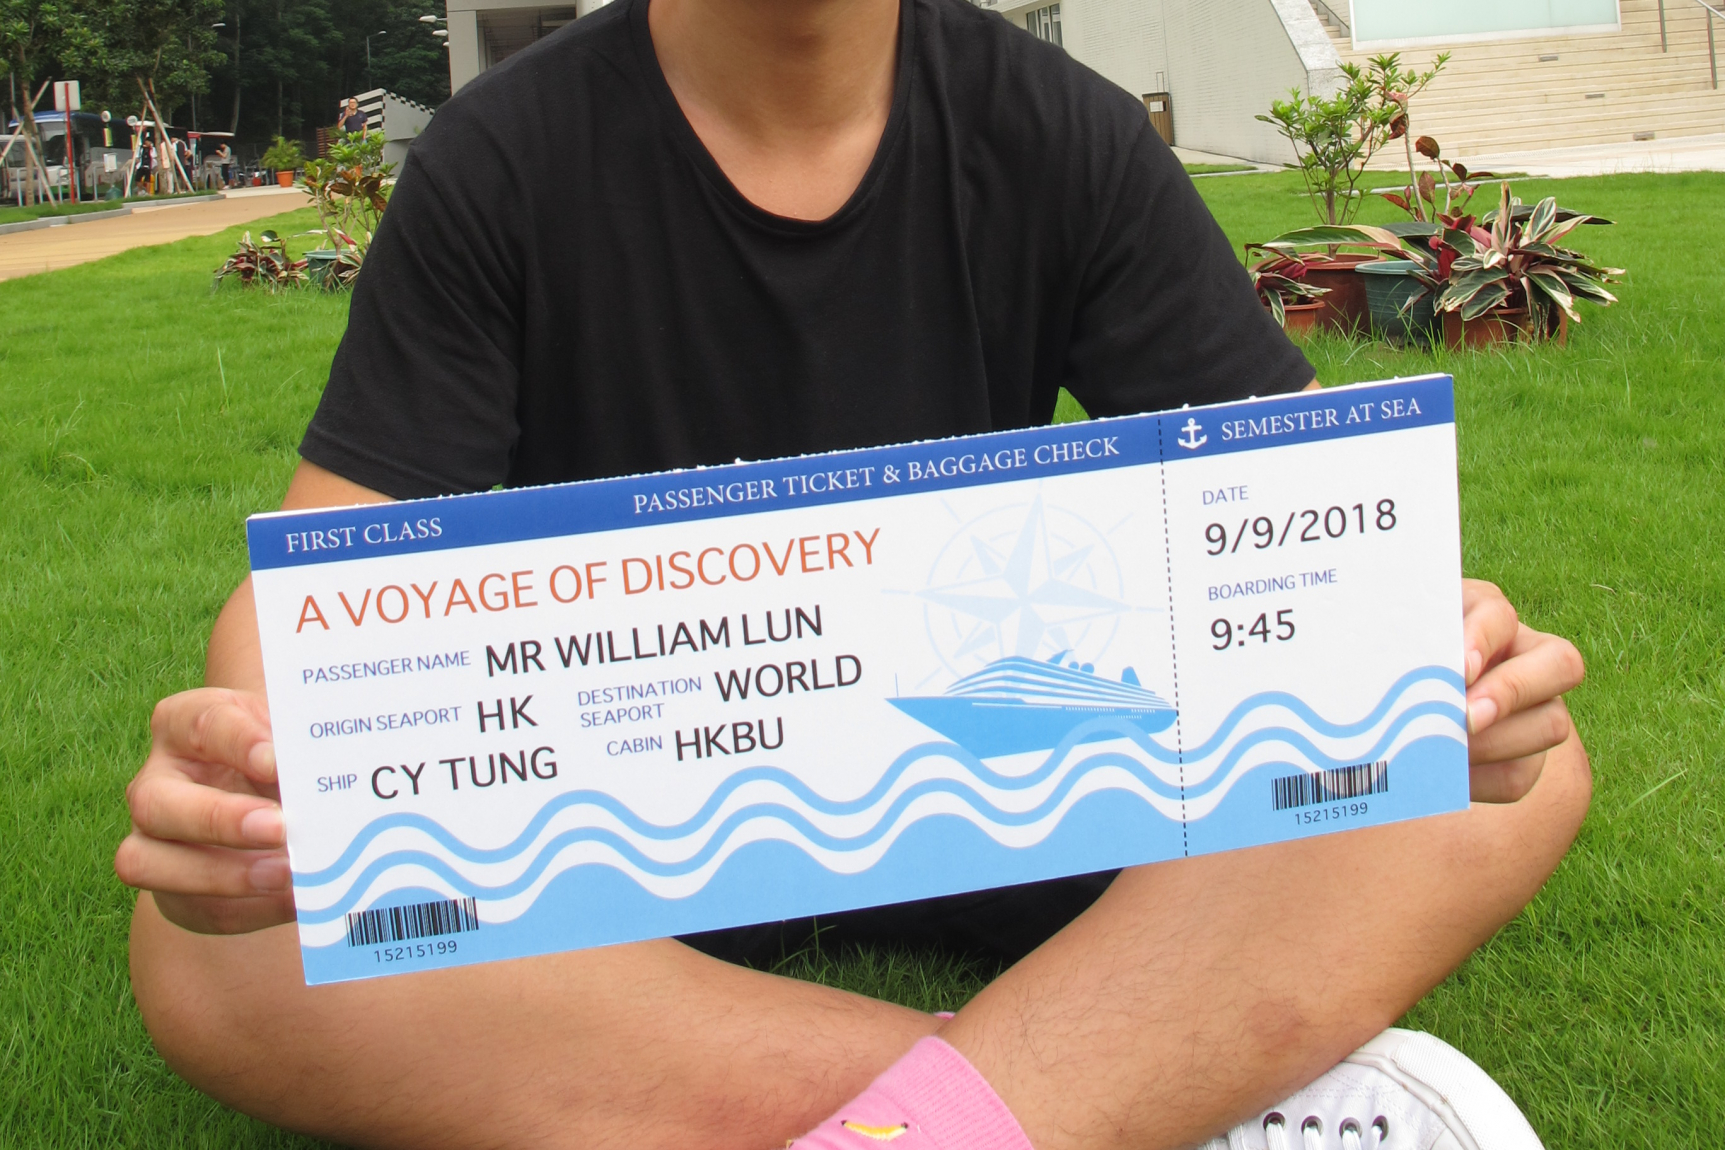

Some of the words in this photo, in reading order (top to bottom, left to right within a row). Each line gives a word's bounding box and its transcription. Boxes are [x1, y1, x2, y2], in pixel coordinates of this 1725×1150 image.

[1221, 410, 1340, 441] SEMESTER
[1345, 403, 1375, 426] AT
[1381, 397, 1422, 419] SEA
[634, 480, 777, 514] PASSENGER
[783, 466, 875, 496] TICKET
[882, 464, 901, 483] &
[907, 448, 1028, 481] BAGGAGE
[1033, 436, 1120, 465] CHECK
[1202, 485, 1249, 505] DATE
[286, 527, 355, 553] FIRST
[364, 518, 443, 545] CLASS
[1204, 498, 1398, 556] 9/9/2018
[296, 595, 330, 633] A
[338, 570, 538, 627] VOYAGE
[548, 561, 608, 604] OF
[622, 527, 881, 595] DISCOVERY
[1207, 574, 1296, 602] BOARDING
[1299, 568, 1338, 590] TIME
[302, 657, 413, 684] PASSENGER
[416, 651, 471, 672] NAME
[484, 639, 546, 678] MR
[554, 616, 731, 670] WILLIAM
[741, 604, 823, 646] LUN
[1209, 608, 1297, 651] 9:45
[577, 676, 702, 707] DESTINATION
[713, 654, 863, 702] WORLD
[309, 715, 372, 740] ORIGIN
[376, 706, 462, 731] SEAPORT
[476, 695, 538, 733] HK
[580, 703, 665, 728] SEAPORT
[606, 735, 663, 757] CABIN
[674, 717, 785, 761] HKBU
[317, 773, 357, 793] SHIP
[370, 762, 427, 800] CY
[439, 746, 558, 790] TUNG
[1294, 802, 1369, 826] 15215199
[374, 939, 458, 963] 15215199
